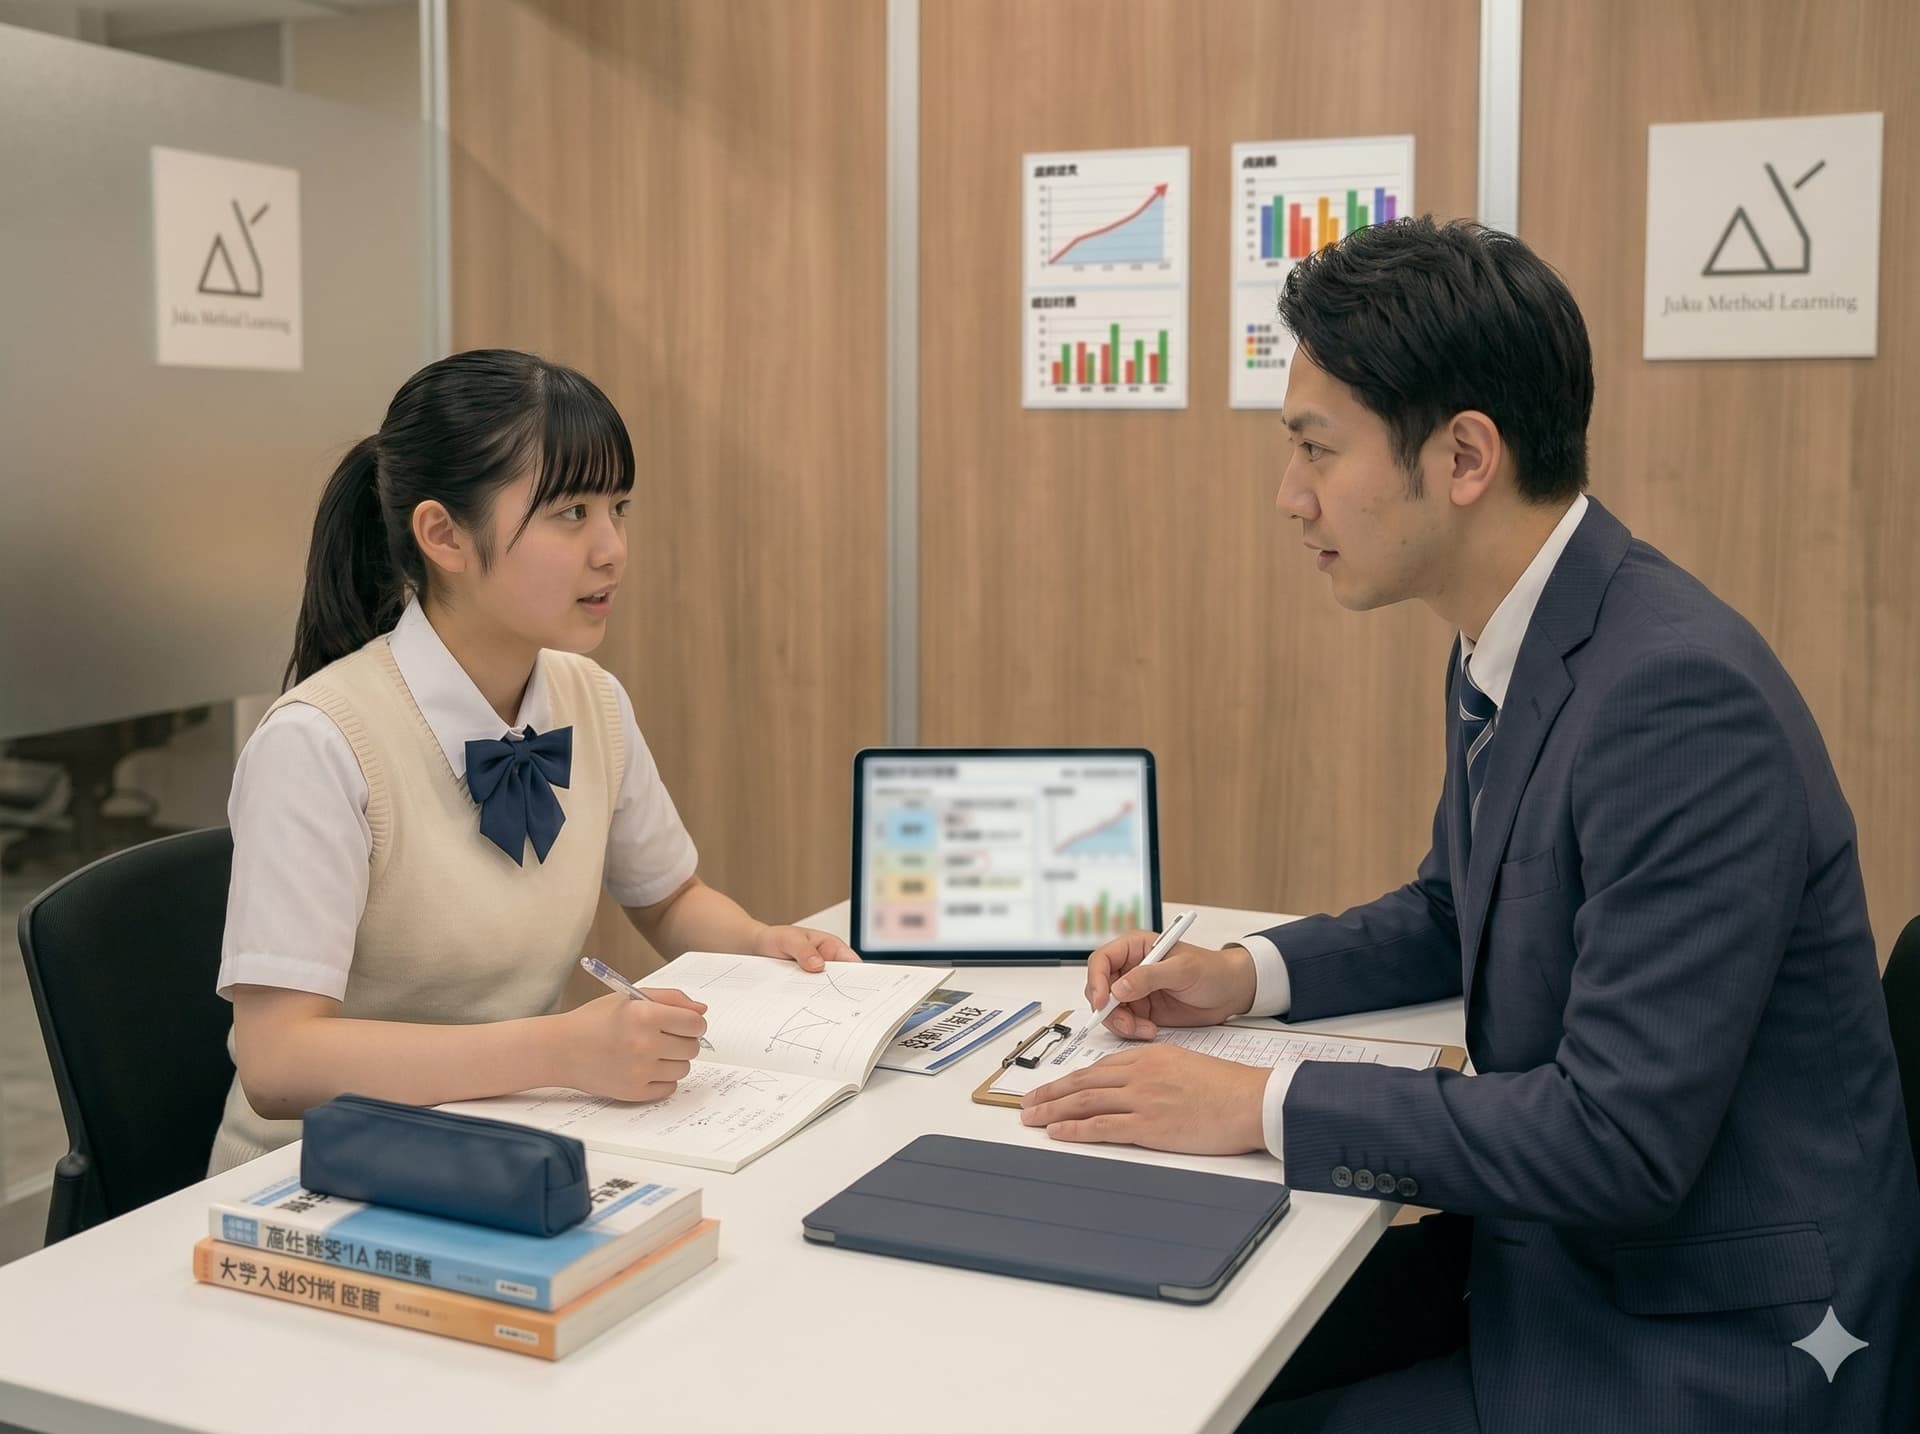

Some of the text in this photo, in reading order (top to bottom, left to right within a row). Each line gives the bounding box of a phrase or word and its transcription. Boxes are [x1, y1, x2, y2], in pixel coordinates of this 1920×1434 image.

[1662, 291, 1858, 316] Juku Method Learning
